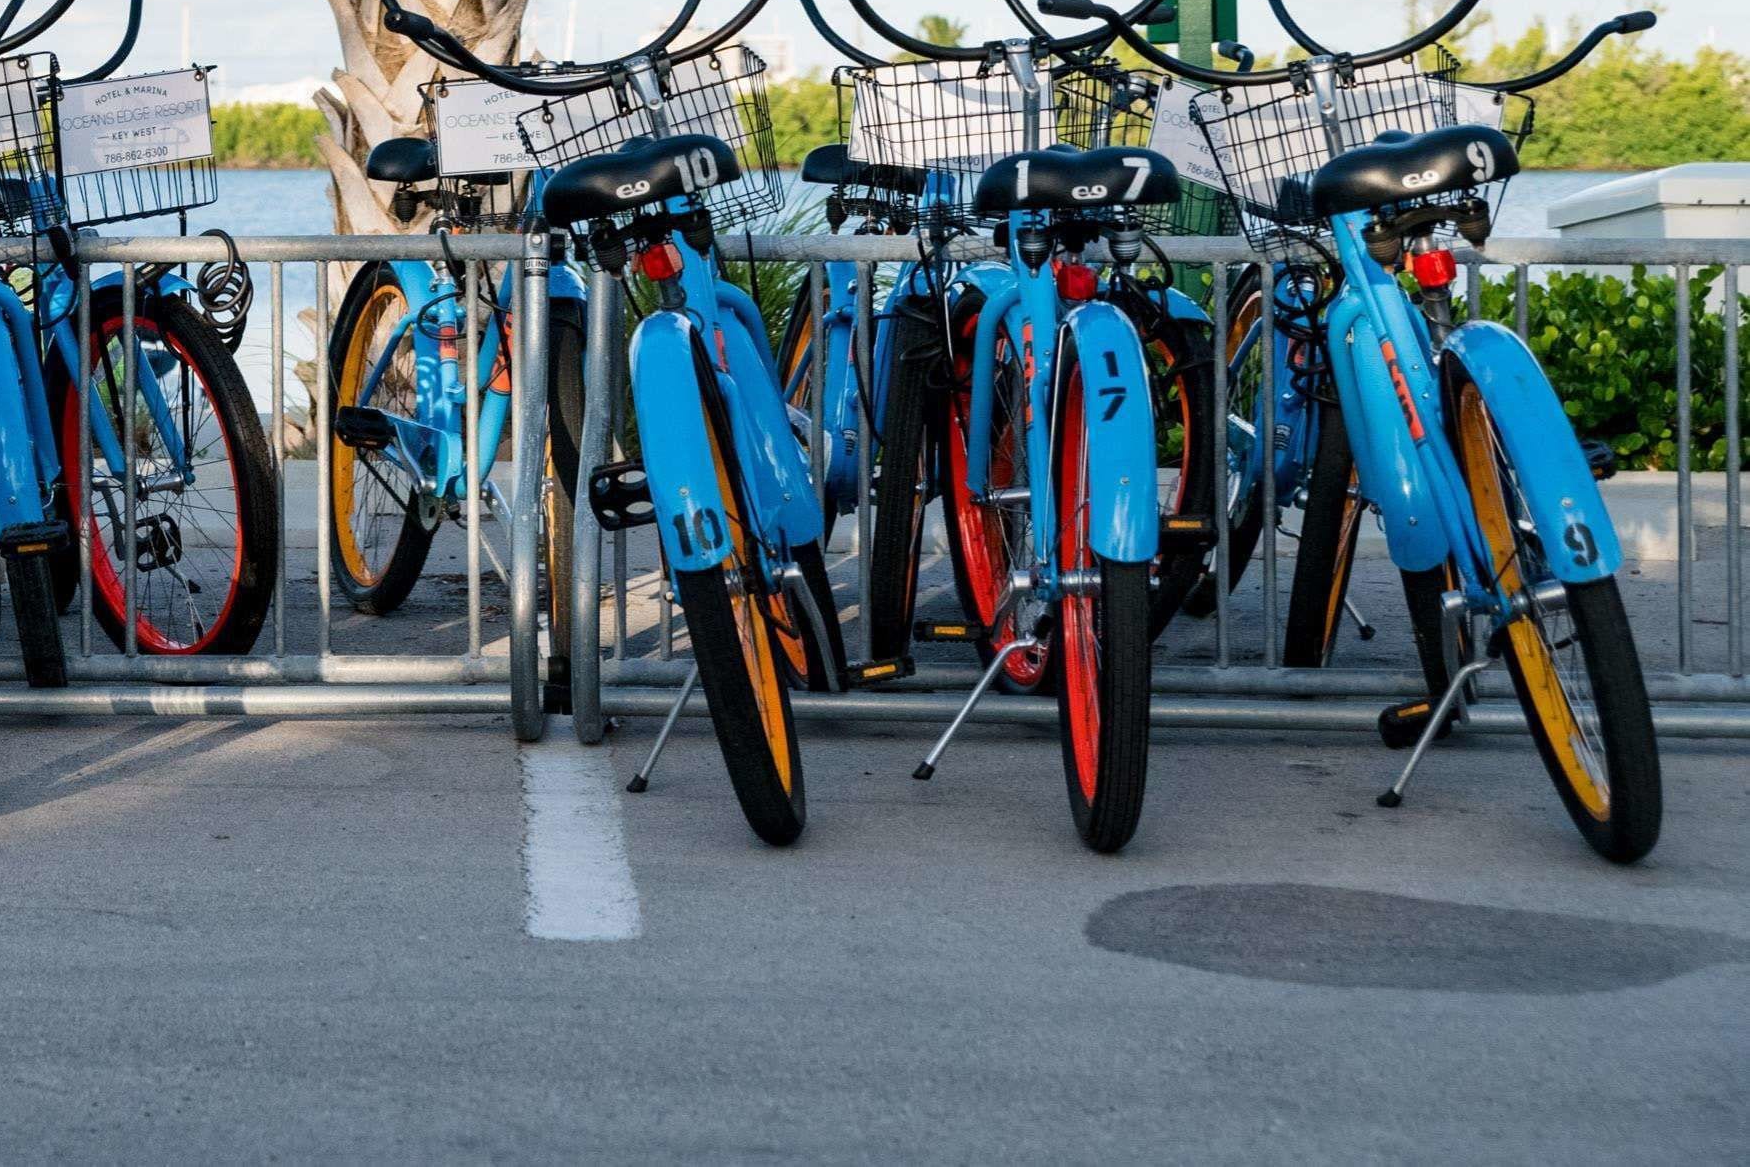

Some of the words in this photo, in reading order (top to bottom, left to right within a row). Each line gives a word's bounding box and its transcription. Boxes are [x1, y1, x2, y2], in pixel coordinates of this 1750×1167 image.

[95, 90, 120, 106] HOTEL
[133, 86, 168, 97] MARINA
[61, 112, 115, 131] OCEANS
[117, 106, 150, 123] EDGE
[155, 99, 201, 118] RESORT
[112, 132, 128, 140] KEY
[132, 126, 157, 137] WEST
[104, 146, 168, 164] 786-862-6300
[674, 149, 719, 193] 10
[1466, 141, 1495, 181] 9
[671, 506, 726, 558] 10
[1564, 522, 1600, 567] 9
